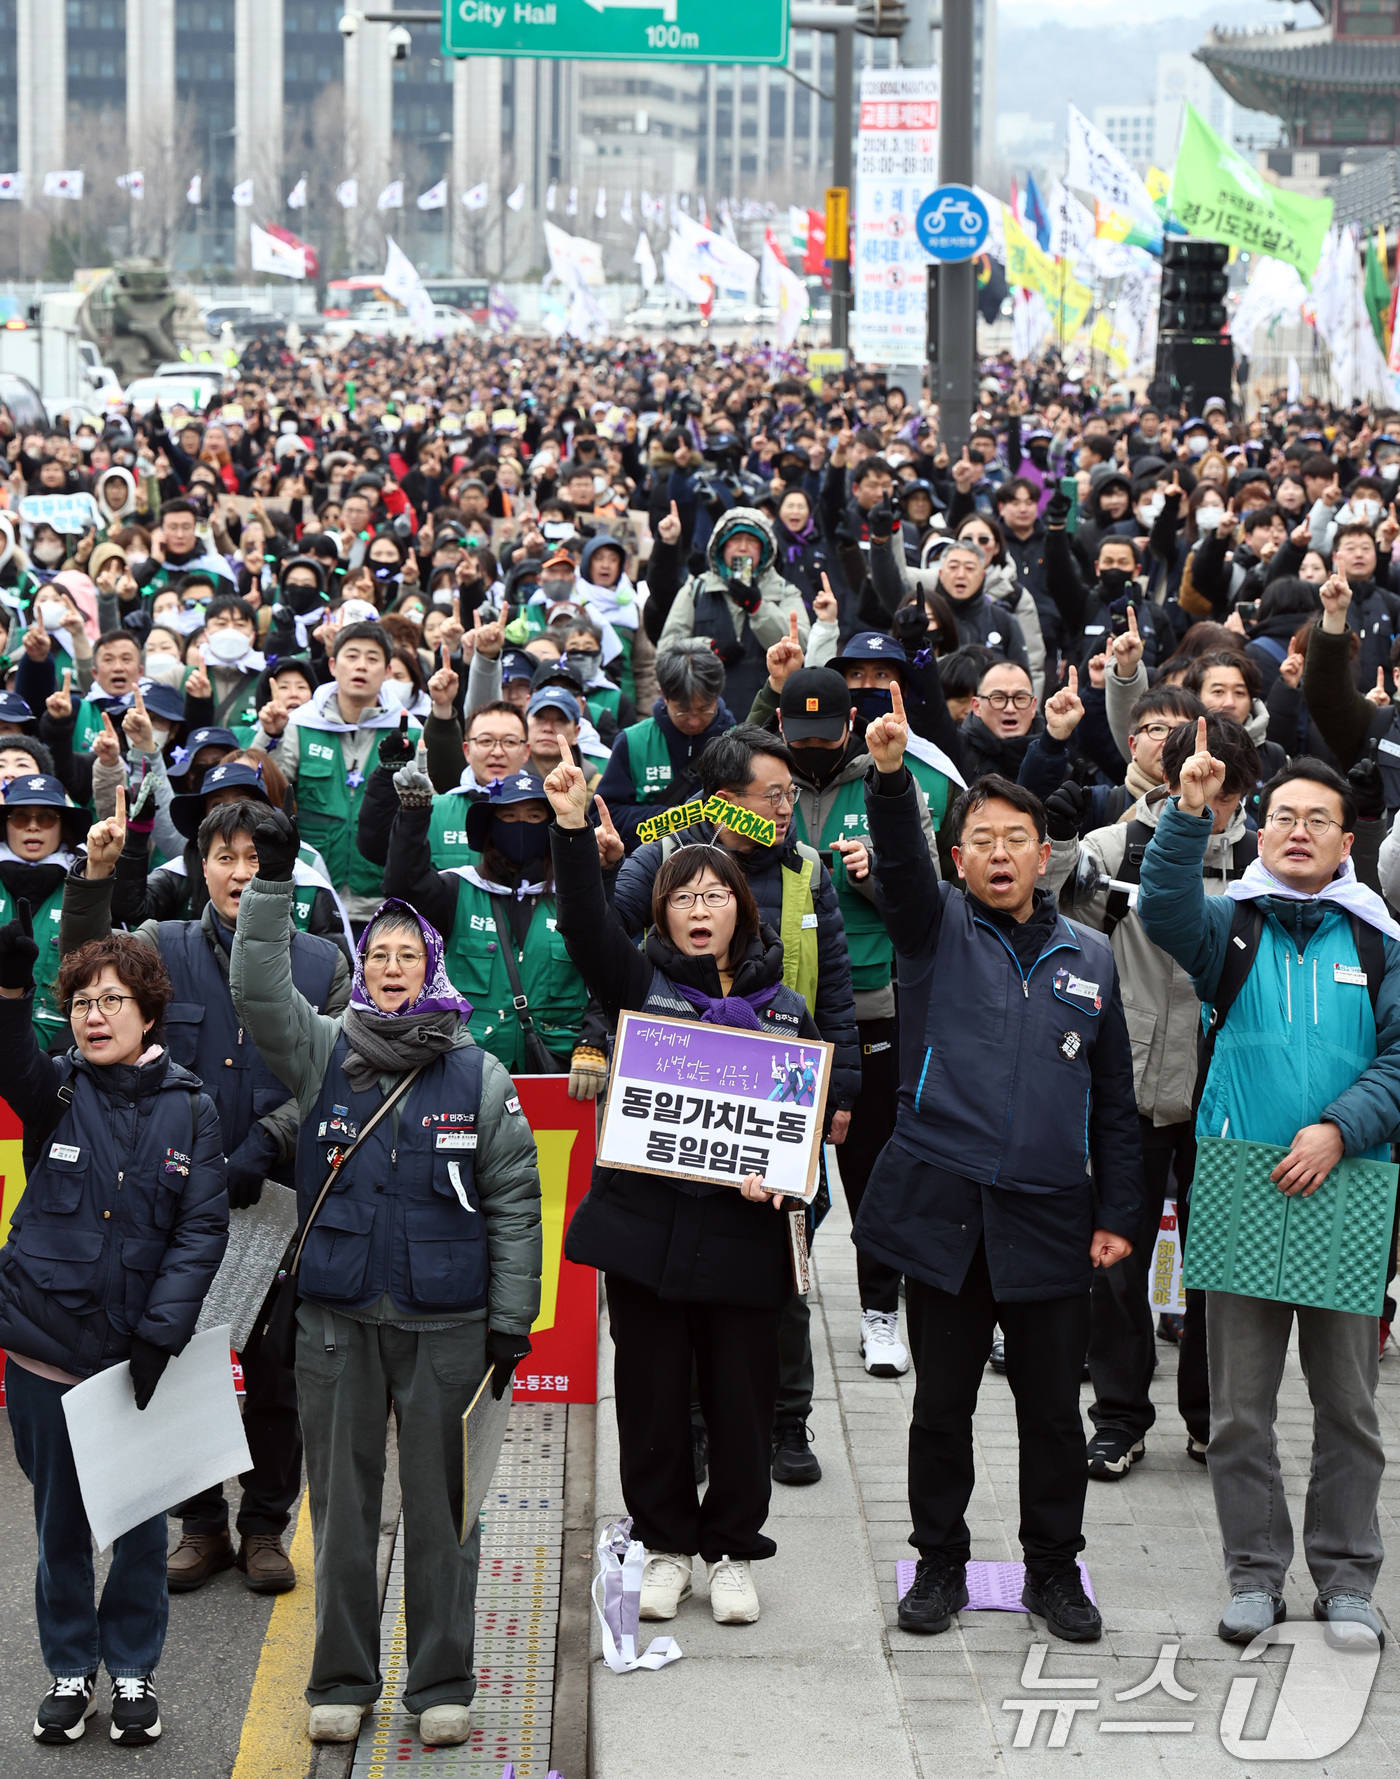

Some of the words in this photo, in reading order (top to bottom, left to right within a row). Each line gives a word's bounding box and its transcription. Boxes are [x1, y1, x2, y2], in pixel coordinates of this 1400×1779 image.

[459, 0, 506, 28] City
[514, 3, 557, 25] Hall
[645, 25, 700, 49] 100m
[308, 743, 335, 761] 단결
[645, 765, 672, 781] 단결
[636, 1027, 691, 1048] 여성에게
[621, 1085, 807, 1144] 동일가치노동
[646, 1130, 770, 1179] 동일임금
